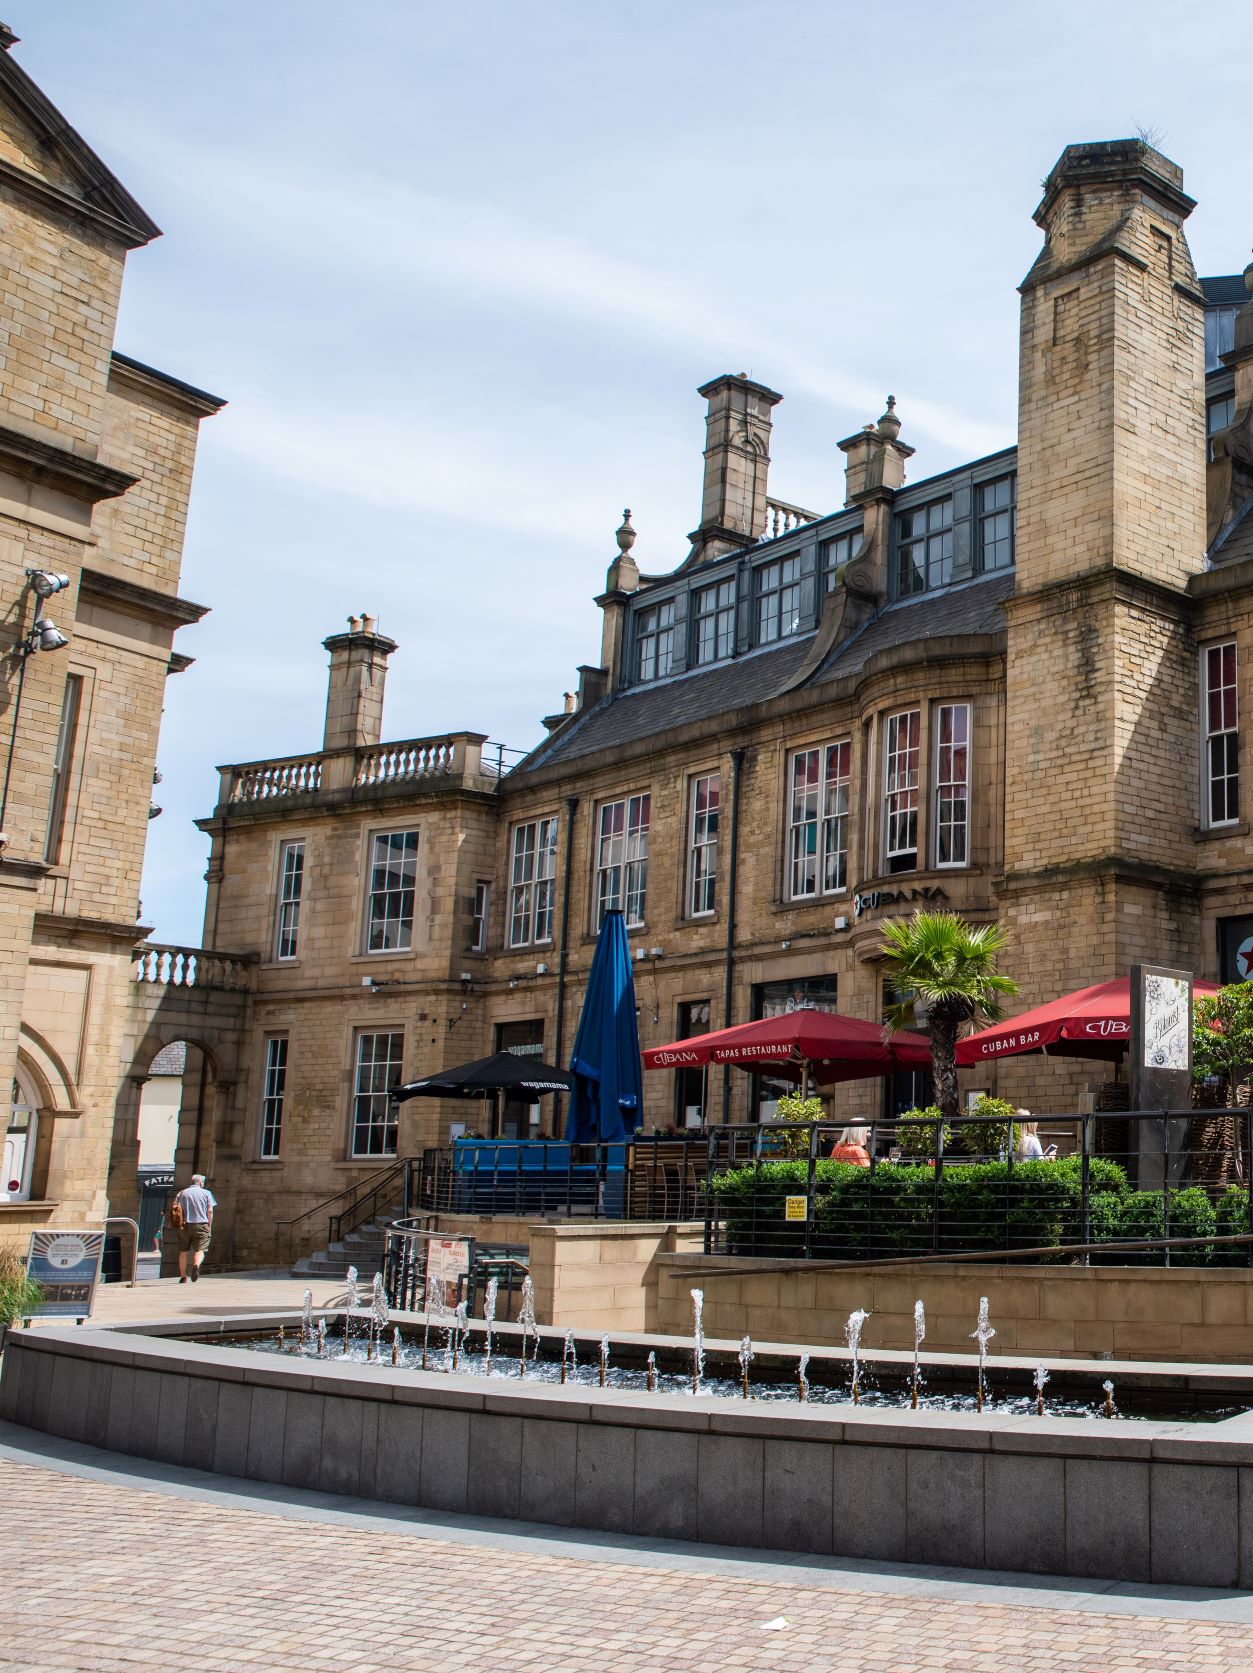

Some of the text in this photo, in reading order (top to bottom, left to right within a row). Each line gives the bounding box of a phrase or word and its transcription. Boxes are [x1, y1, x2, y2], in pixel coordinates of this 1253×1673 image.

[860, 887, 951, 911] CUBANA
[1085, 1020, 1131, 1036] CUB
[982, 1031, 1041, 1054] CUBAN BAR
[653, 1051, 699, 1066] CUBANA
[716, 1044, 793, 1059] TAPAS RESTAURANT
[520, 1081, 570, 1090] wagamama
